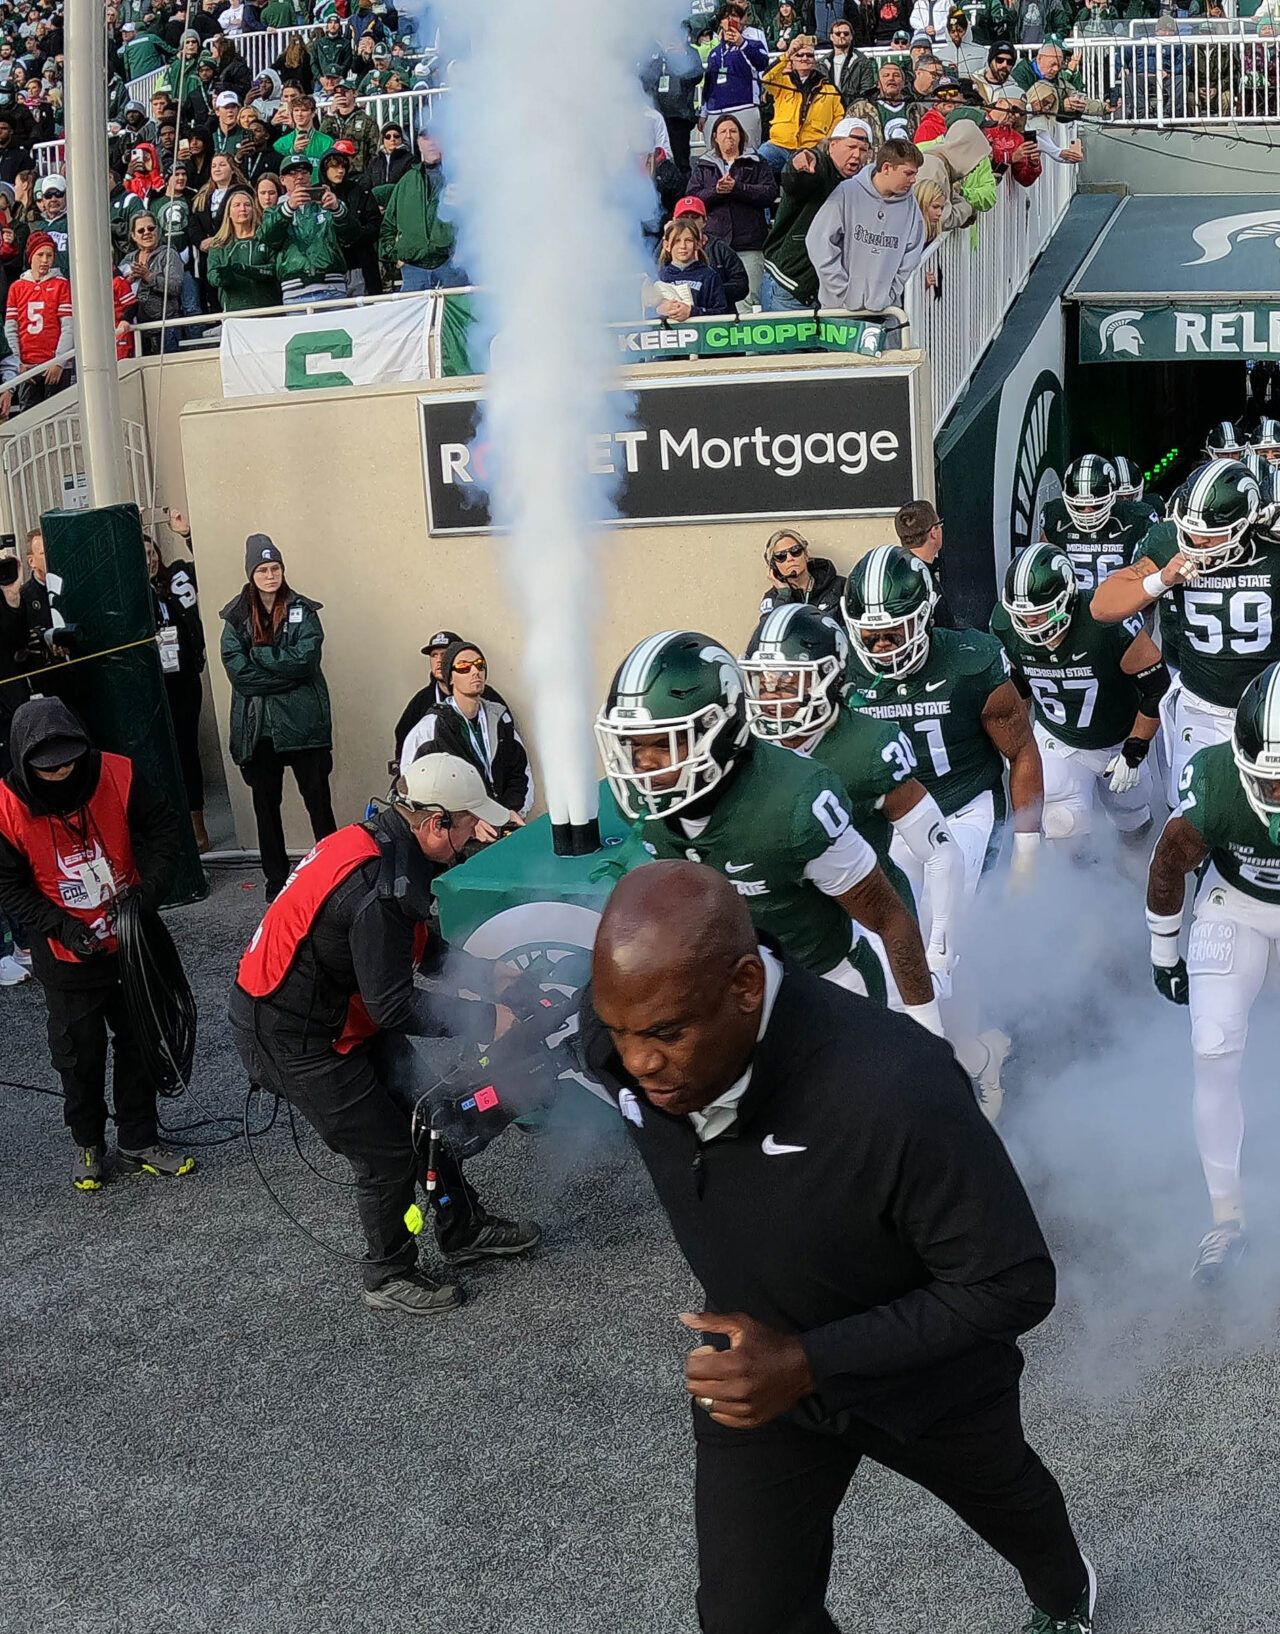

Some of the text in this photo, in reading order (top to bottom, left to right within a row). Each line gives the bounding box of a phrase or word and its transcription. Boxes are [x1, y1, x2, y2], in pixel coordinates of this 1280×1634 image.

[854, 224, 899, 249] Steelers
[27, 301, 44, 334] 5
[618, 329, 698, 352] KEEP
[660, 425, 898, 477] Mortgage
[1066, 543, 1124, 553] MICHIGAN STATE
[170, 570, 197, 609] S
[1182, 574, 1272, 590] MICHIGAN STATE
[1184, 590, 1273, 654] 59
[1023, 665, 1094, 679] MICHIGAN STATE
[914, 700, 951, 716] STATE
[1028, 678, 1099, 729] 67
[812, 789, 850, 838] 0
